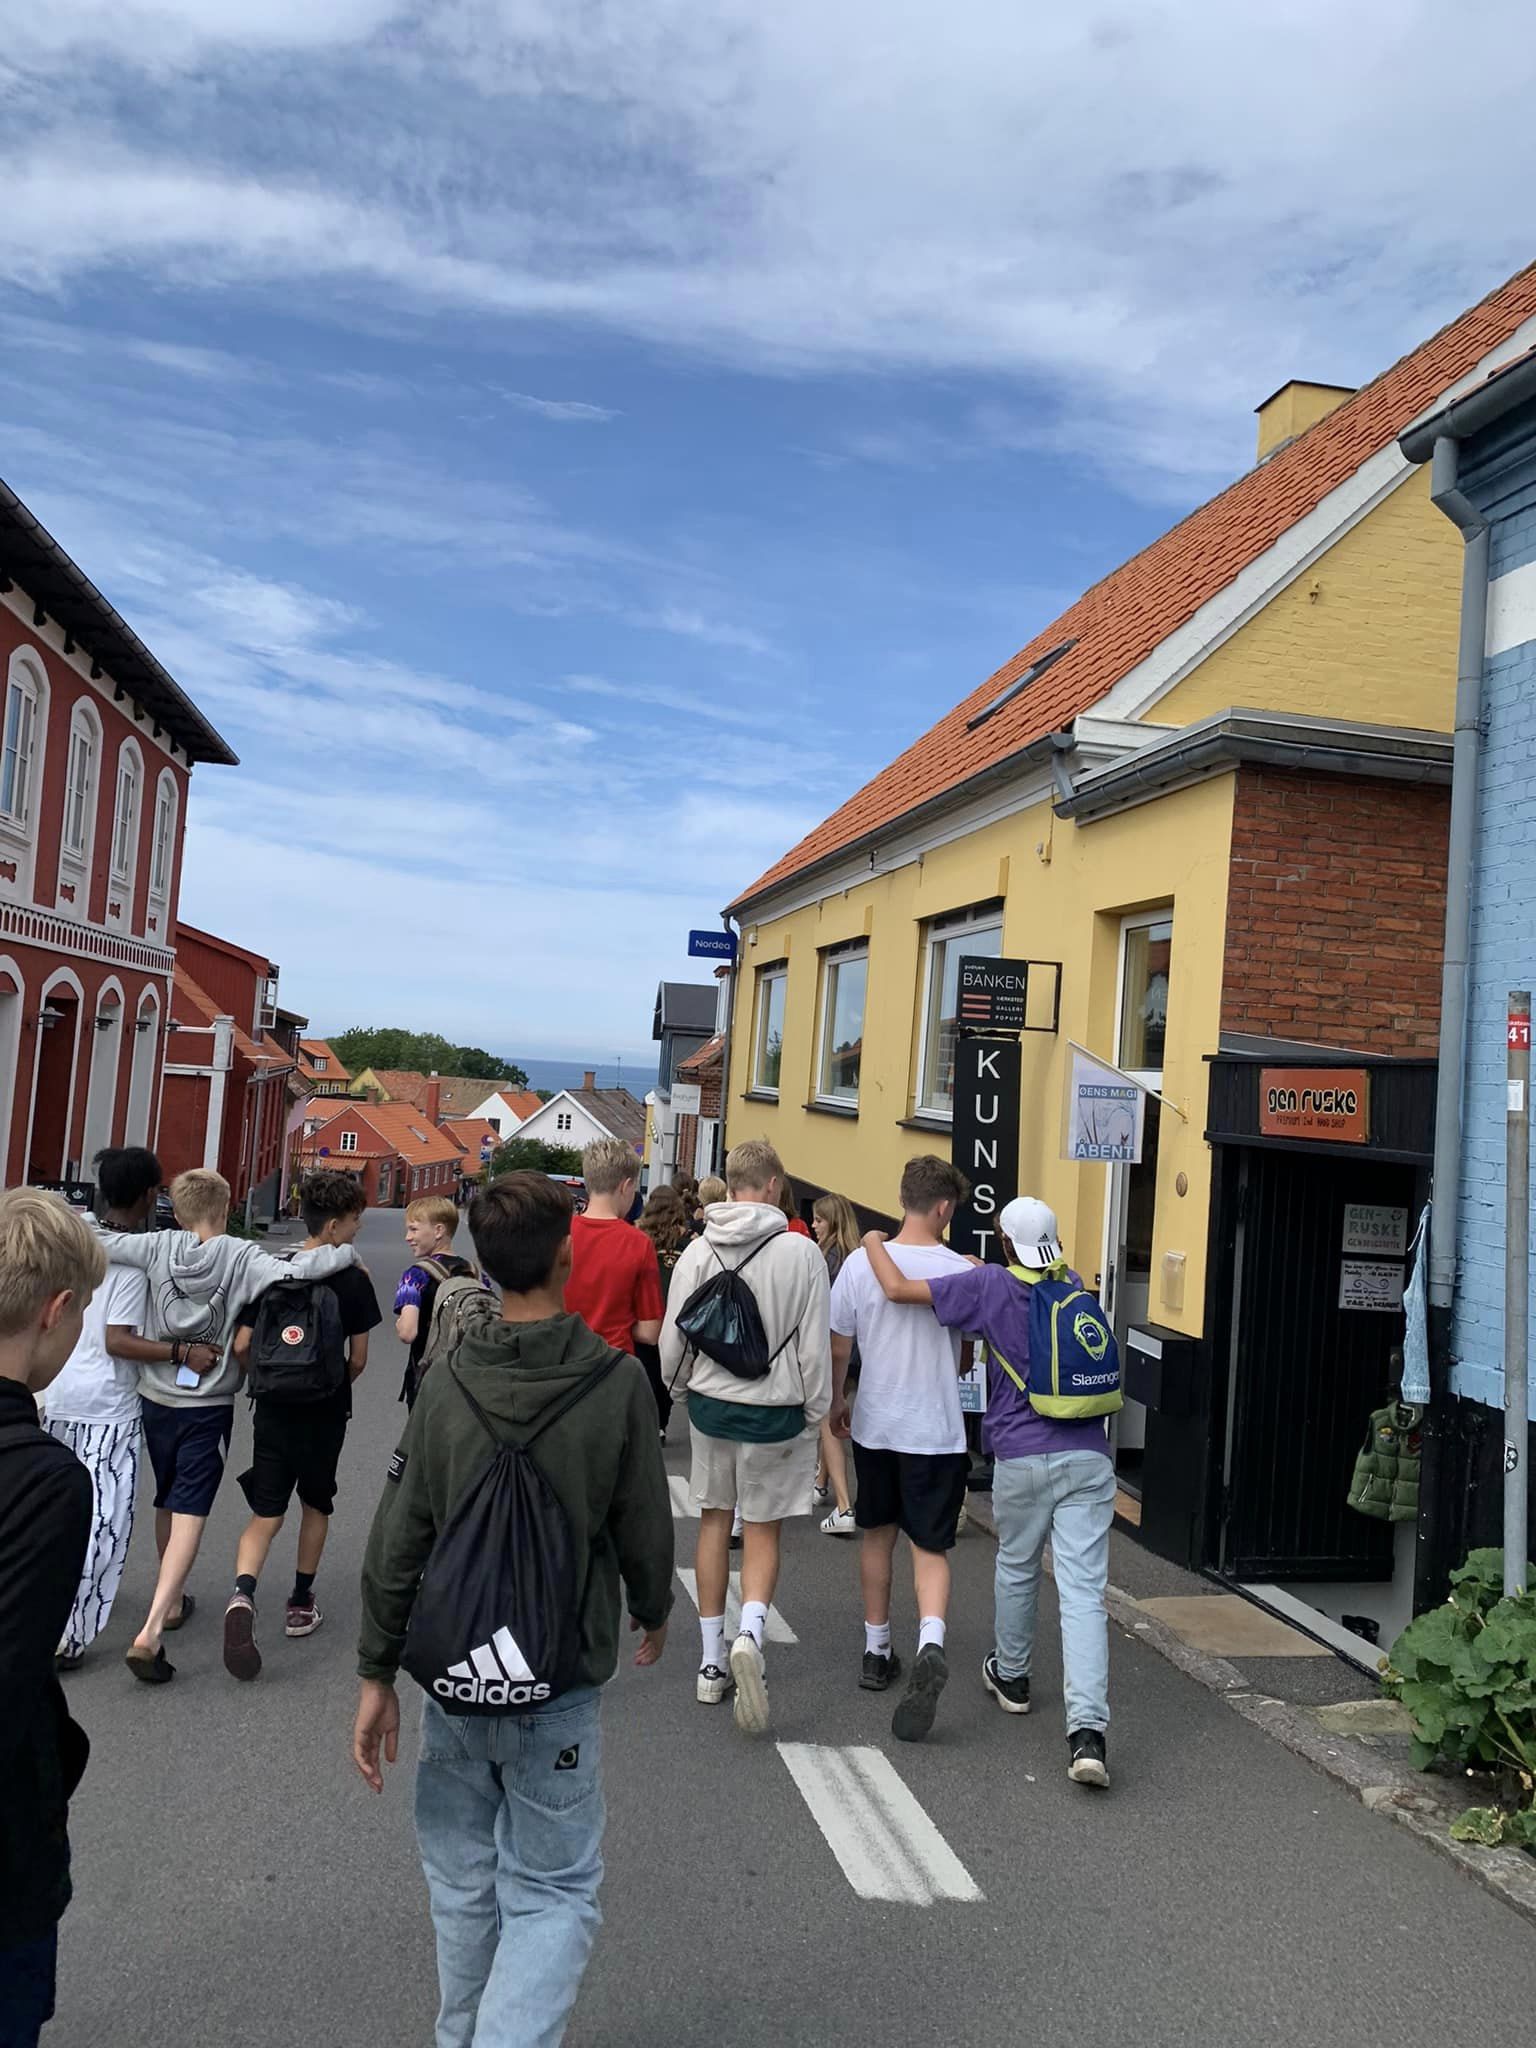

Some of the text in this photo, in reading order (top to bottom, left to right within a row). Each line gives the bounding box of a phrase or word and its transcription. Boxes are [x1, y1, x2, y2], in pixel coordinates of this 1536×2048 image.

[695, 940, 731, 950] Nordea
[963, 972, 1025, 990] BANKEN
[1508, 1027, 1528, 1043] 41
[1079, 1087, 1137, 1098] ØENS MAGI
[1267, 1086, 1358, 1116] gen ruske
[972, 1050, 1001, 1259] KUNST
[1076, 1138, 1134, 1159] ÅBENT
[1348, 1220, 1401, 1237] RUSKE
[1072, 1370, 1120, 1386] Slazenge
[433, 1677, 551, 1705] adidas
